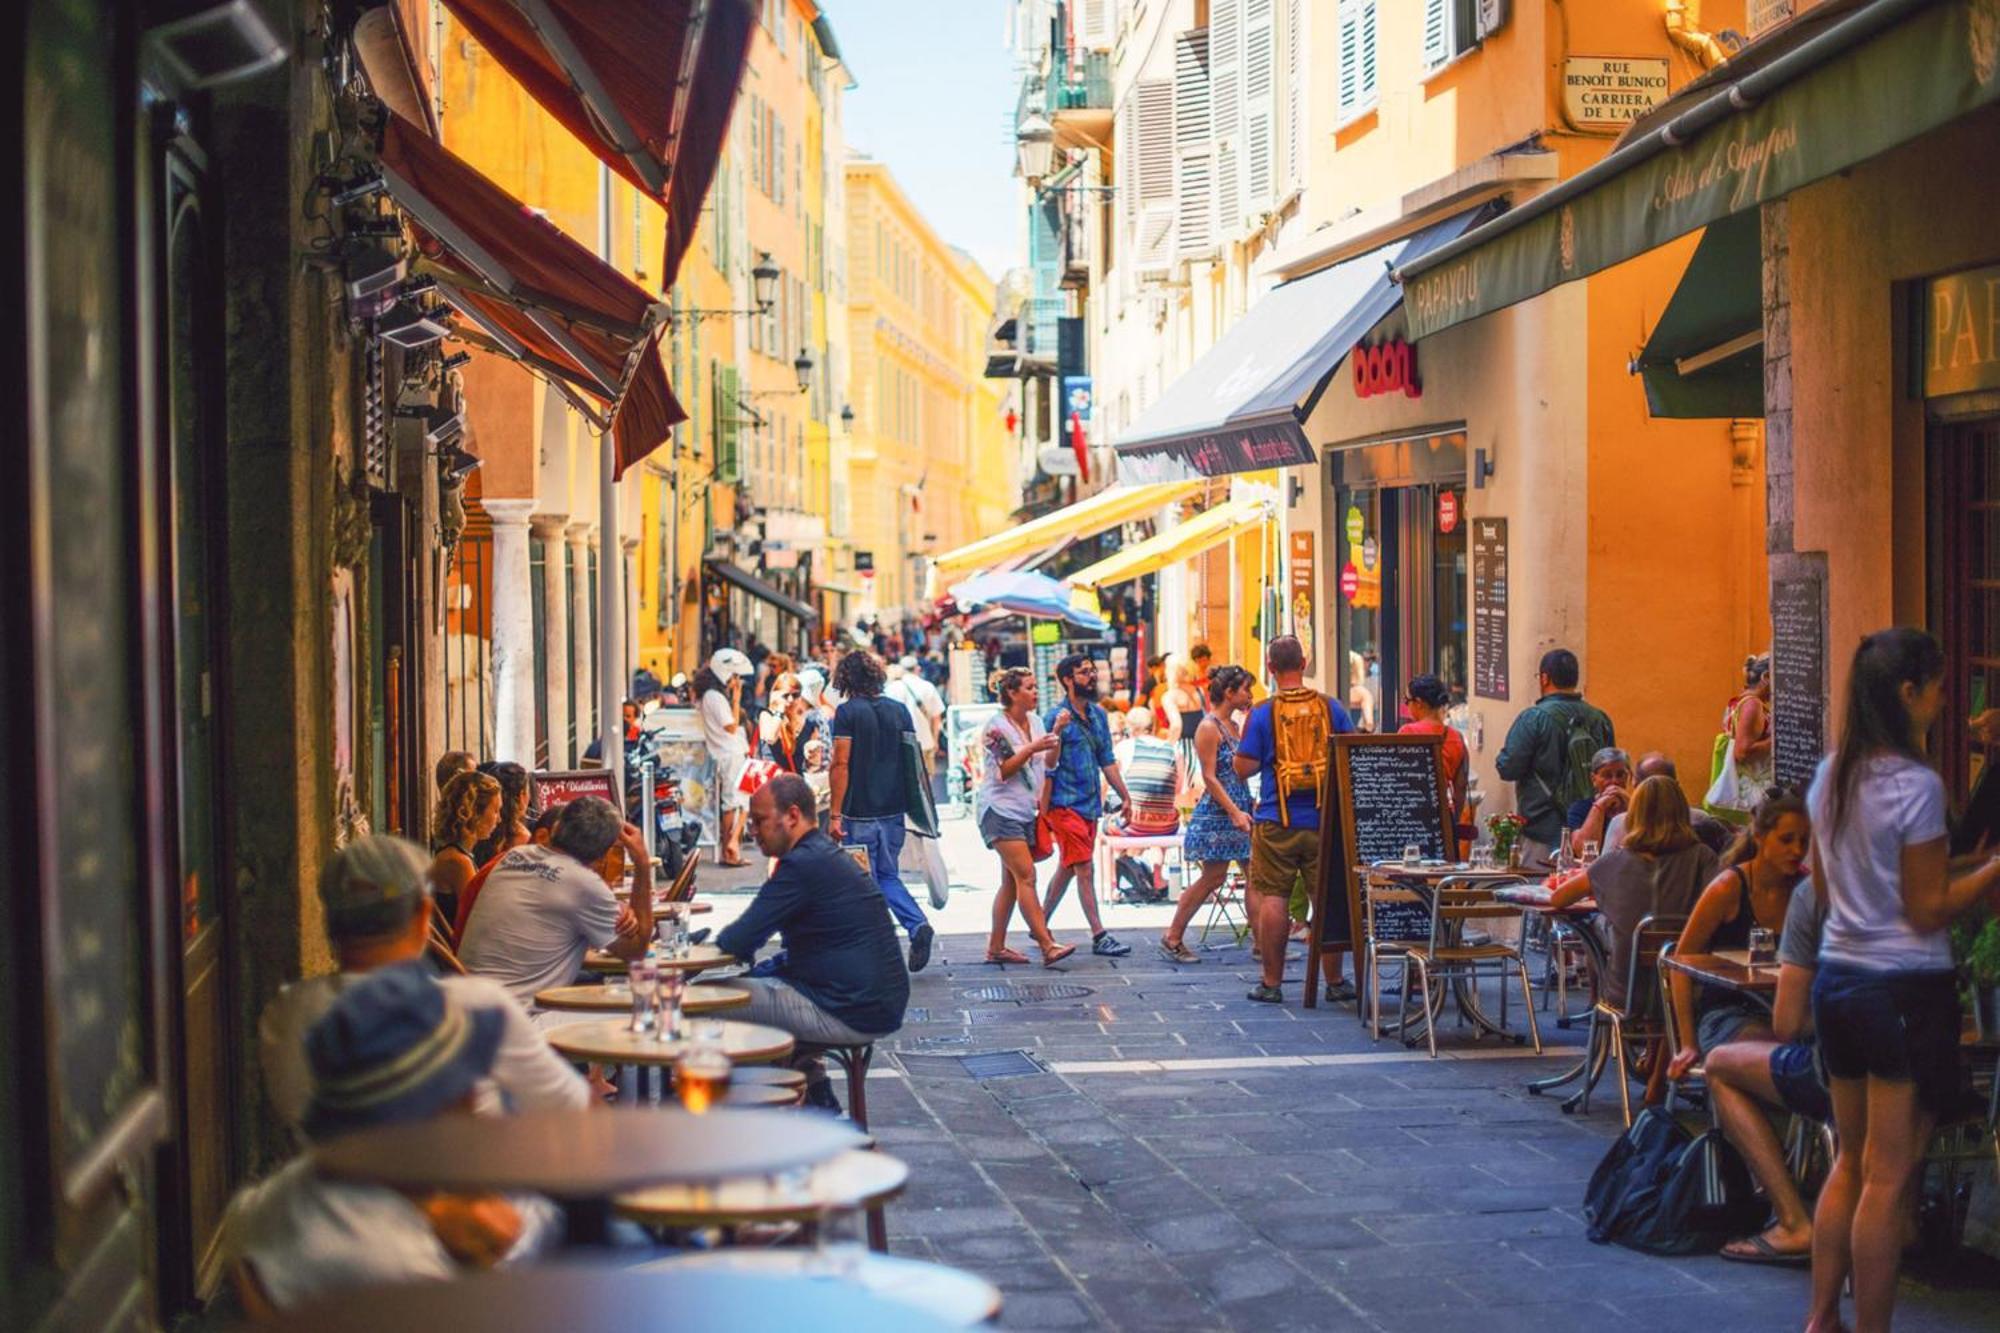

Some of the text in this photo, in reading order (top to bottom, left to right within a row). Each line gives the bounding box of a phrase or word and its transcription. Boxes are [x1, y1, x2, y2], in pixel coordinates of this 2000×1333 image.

[1603, 62, 1631, 74] RUE
[1617, 75, 1667, 88] BUNICO
[1581, 93, 1653, 106] CARRIERA
[1584, 107, 1602, 118] DE
[1417, 259, 1478, 319] PAPAYOU
